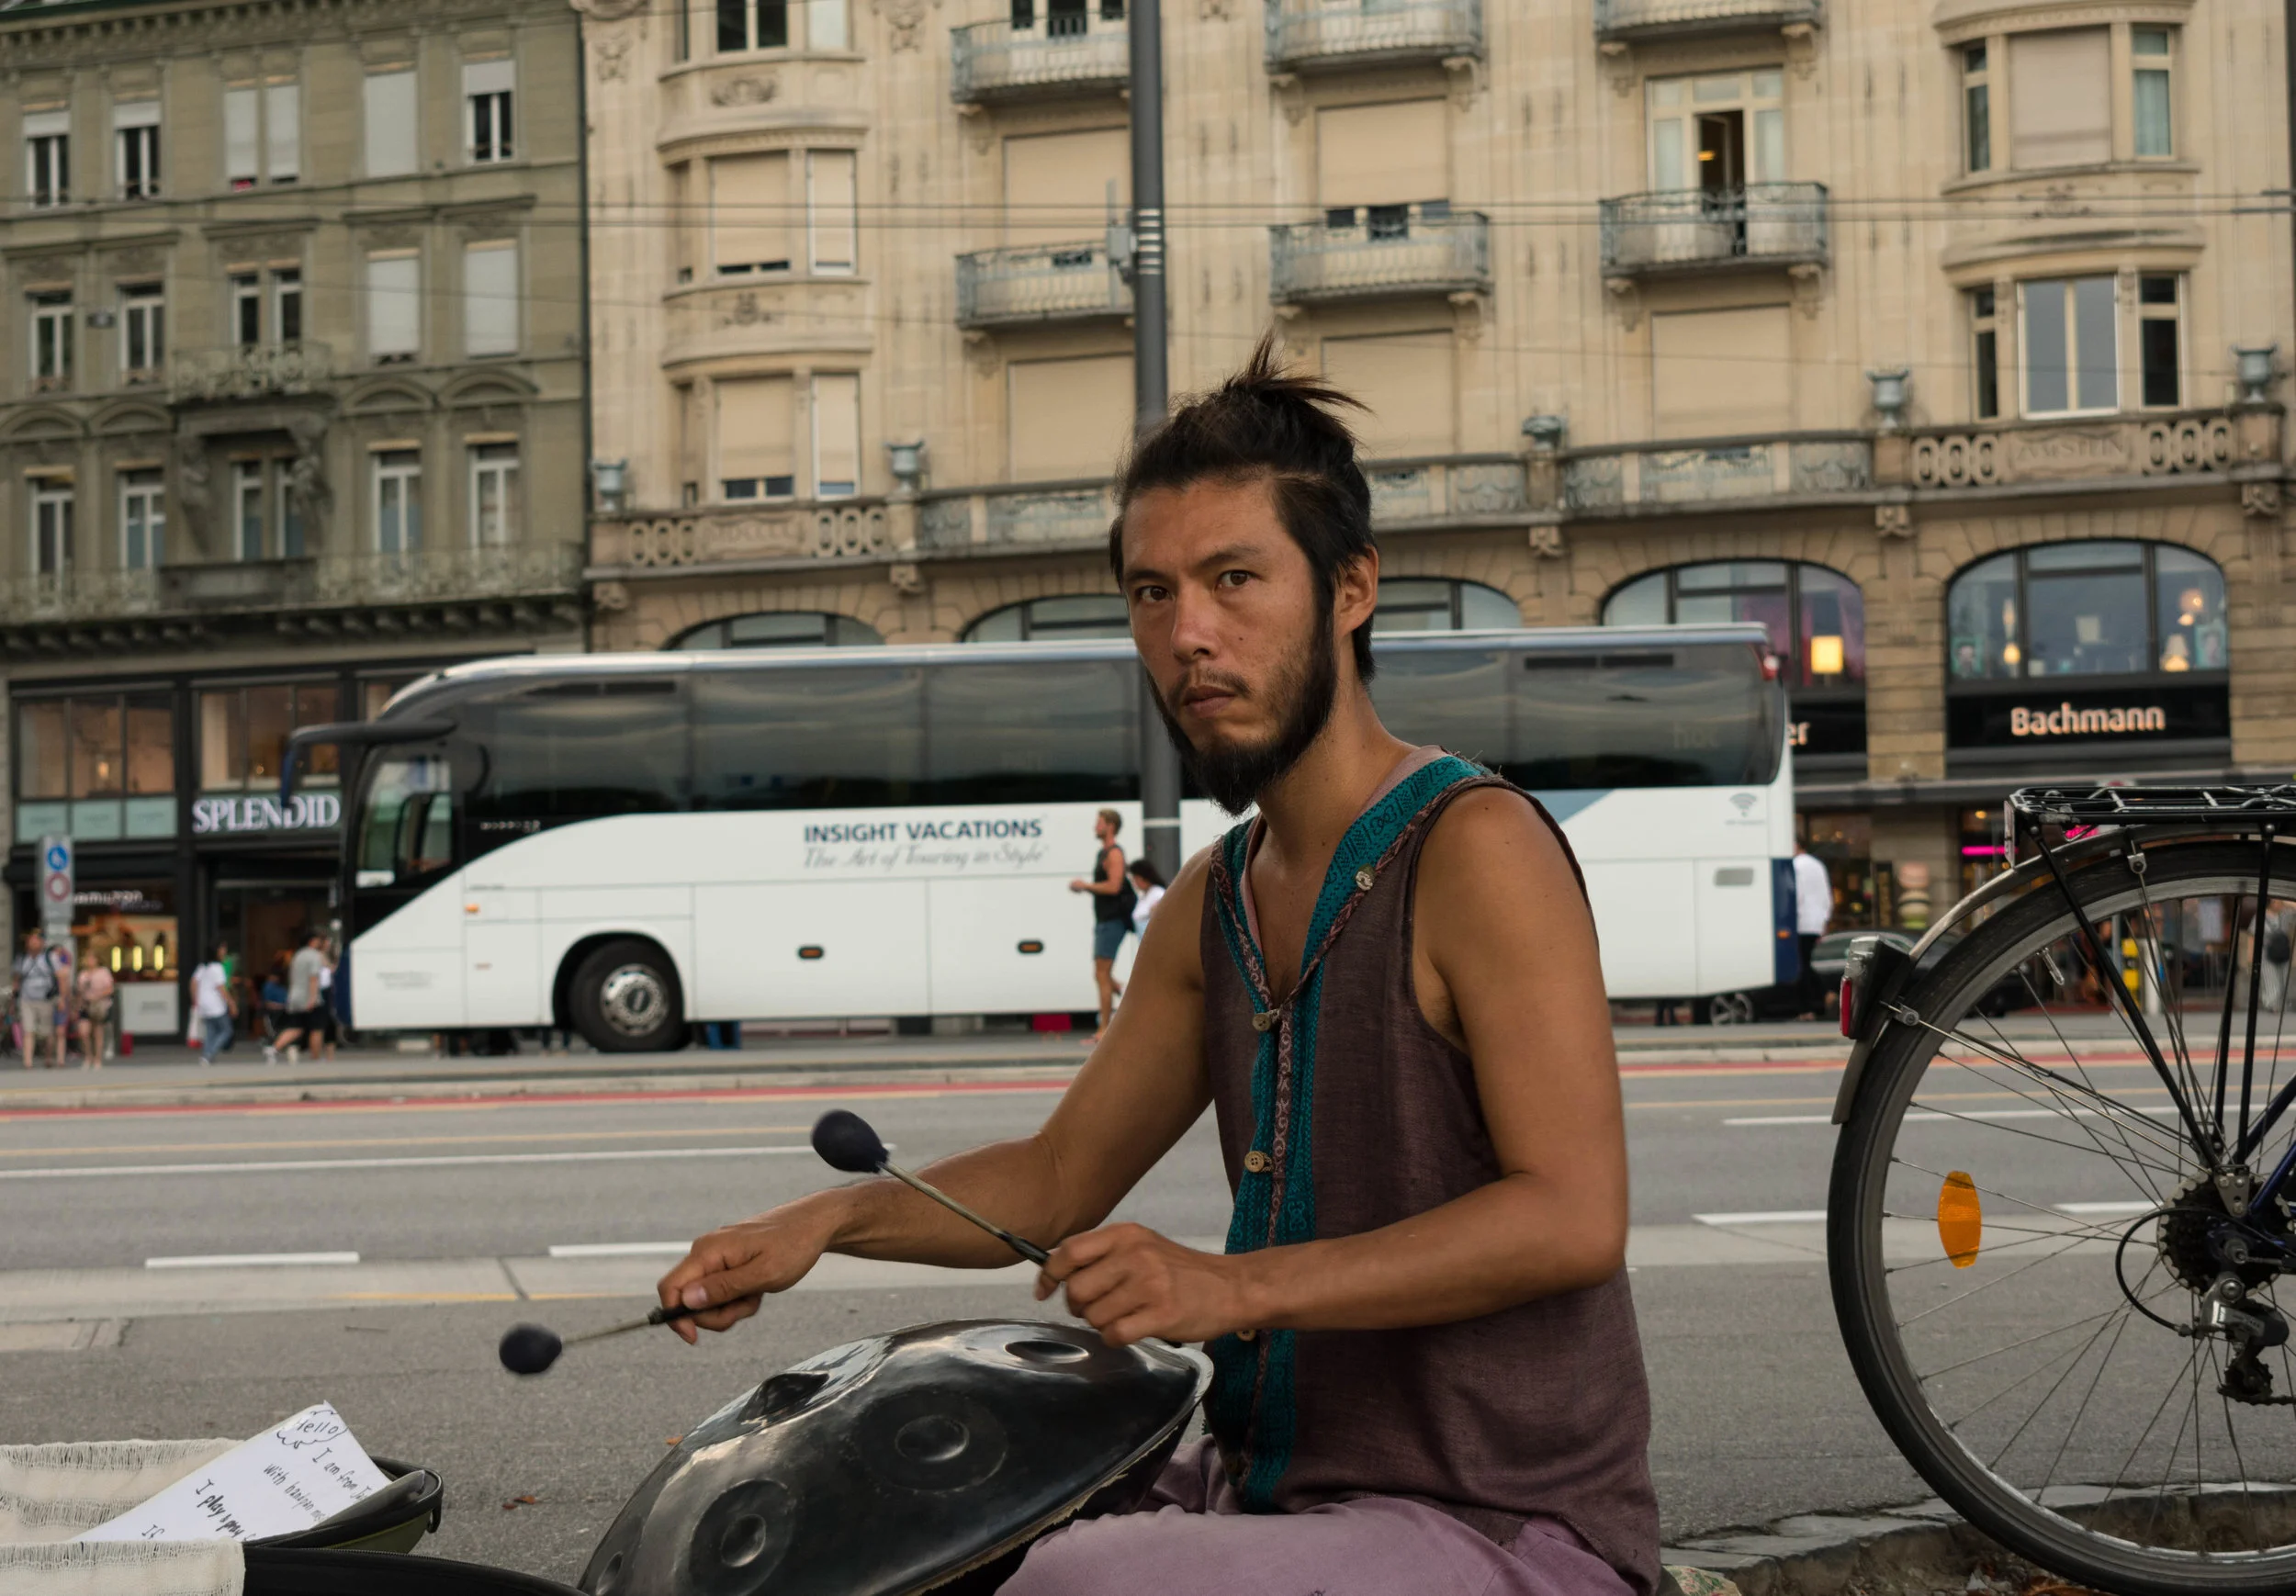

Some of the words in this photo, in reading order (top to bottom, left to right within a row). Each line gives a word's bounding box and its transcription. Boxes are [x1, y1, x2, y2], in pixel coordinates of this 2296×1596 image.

[2010, 702, 2166, 736] Bachmann
[192, 794, 341, 833] SPLENDID
[804, 823, 897, 843] INSIGHT
[906, 818, 1043, 841] VACATIONS
[803, 846, 837, 868] The
[845, 847, 879, 868] Art
[881, 846, 902, 871] of
[905, 844, 969, 871] Touring
[312, 1446, 332, 1463] I
[323, 1462, 341, 1476] am
[335, 1469, 358, 1490] from
[196, 1478, 215, 1495] I
[197, 1495, 227, 1518] play
